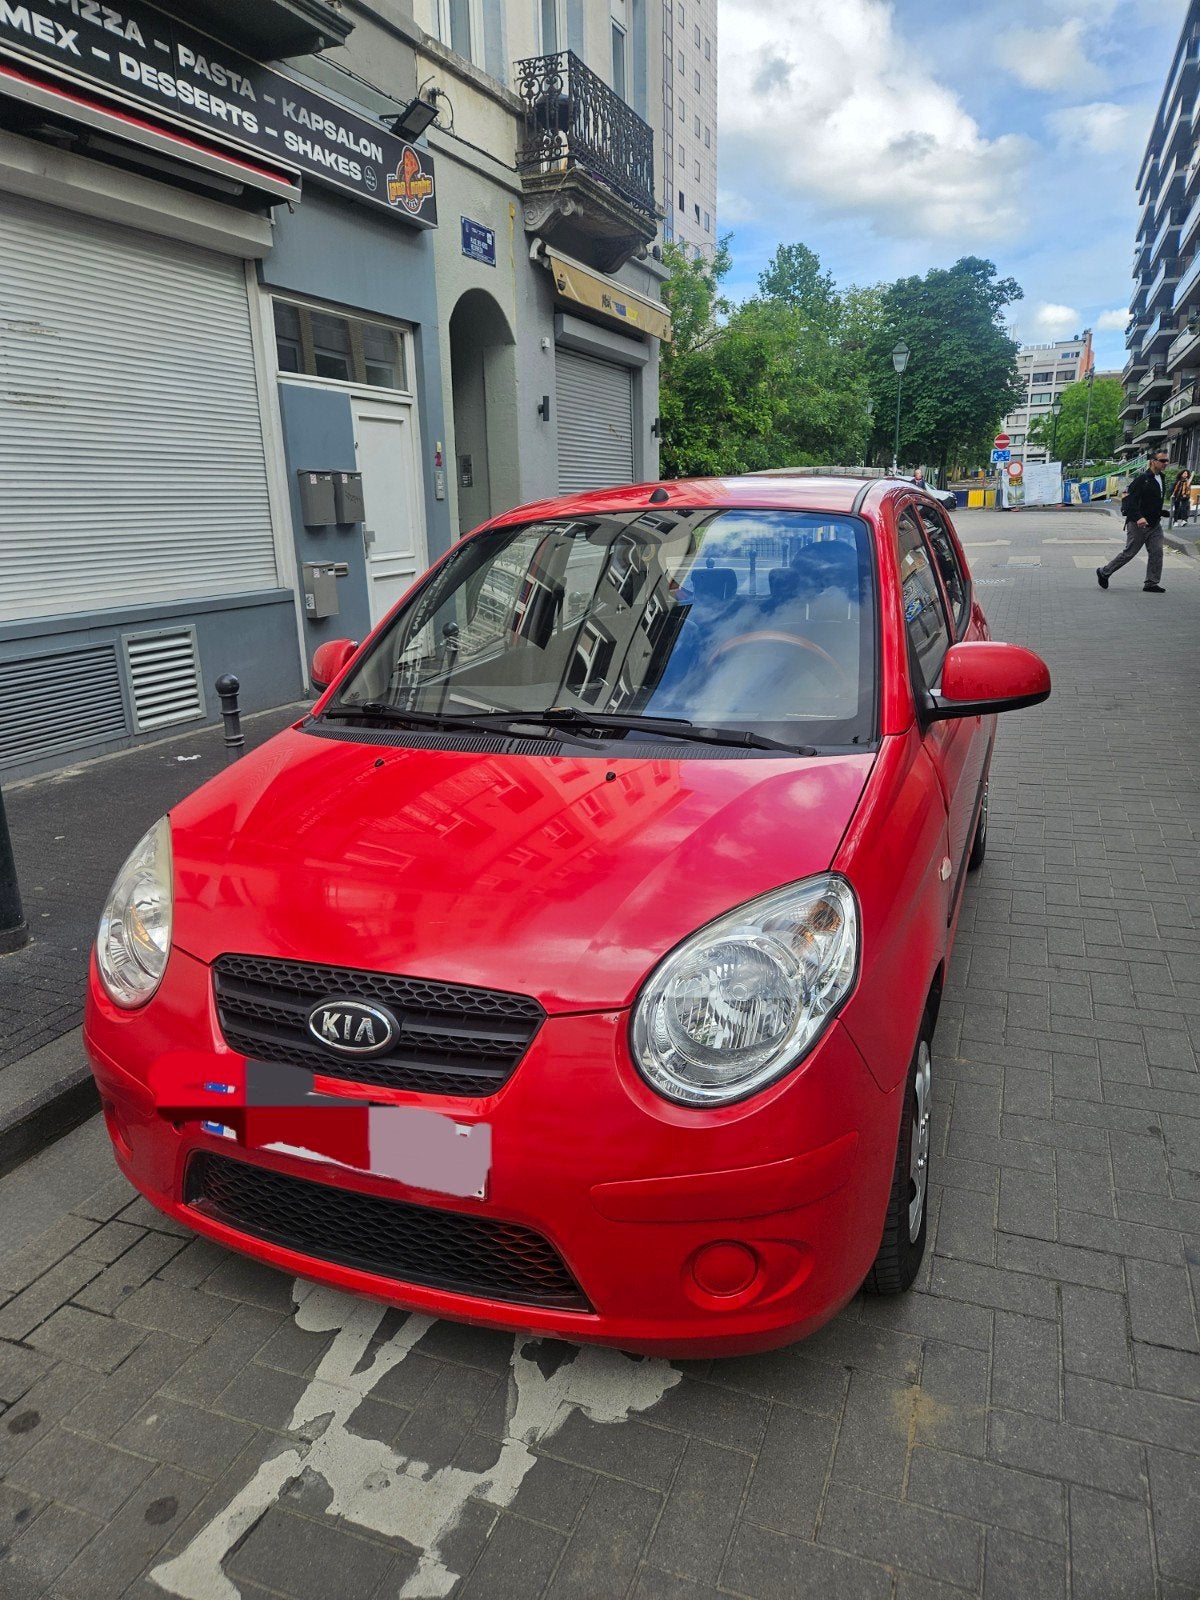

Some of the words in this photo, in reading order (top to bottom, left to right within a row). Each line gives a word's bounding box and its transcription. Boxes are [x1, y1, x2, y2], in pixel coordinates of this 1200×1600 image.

[0, 0, 82, 57] MEX
[118, 51, 259, 134] DESSERTS
[283, 130, 363, 181] SHAKES
[48, 0, 147, 49] IZZA
[177, 43, 257, 103] PASTA
[281, 97, 384, 165] KAPSALON
[321, 1010, 376, 1044] KIA
